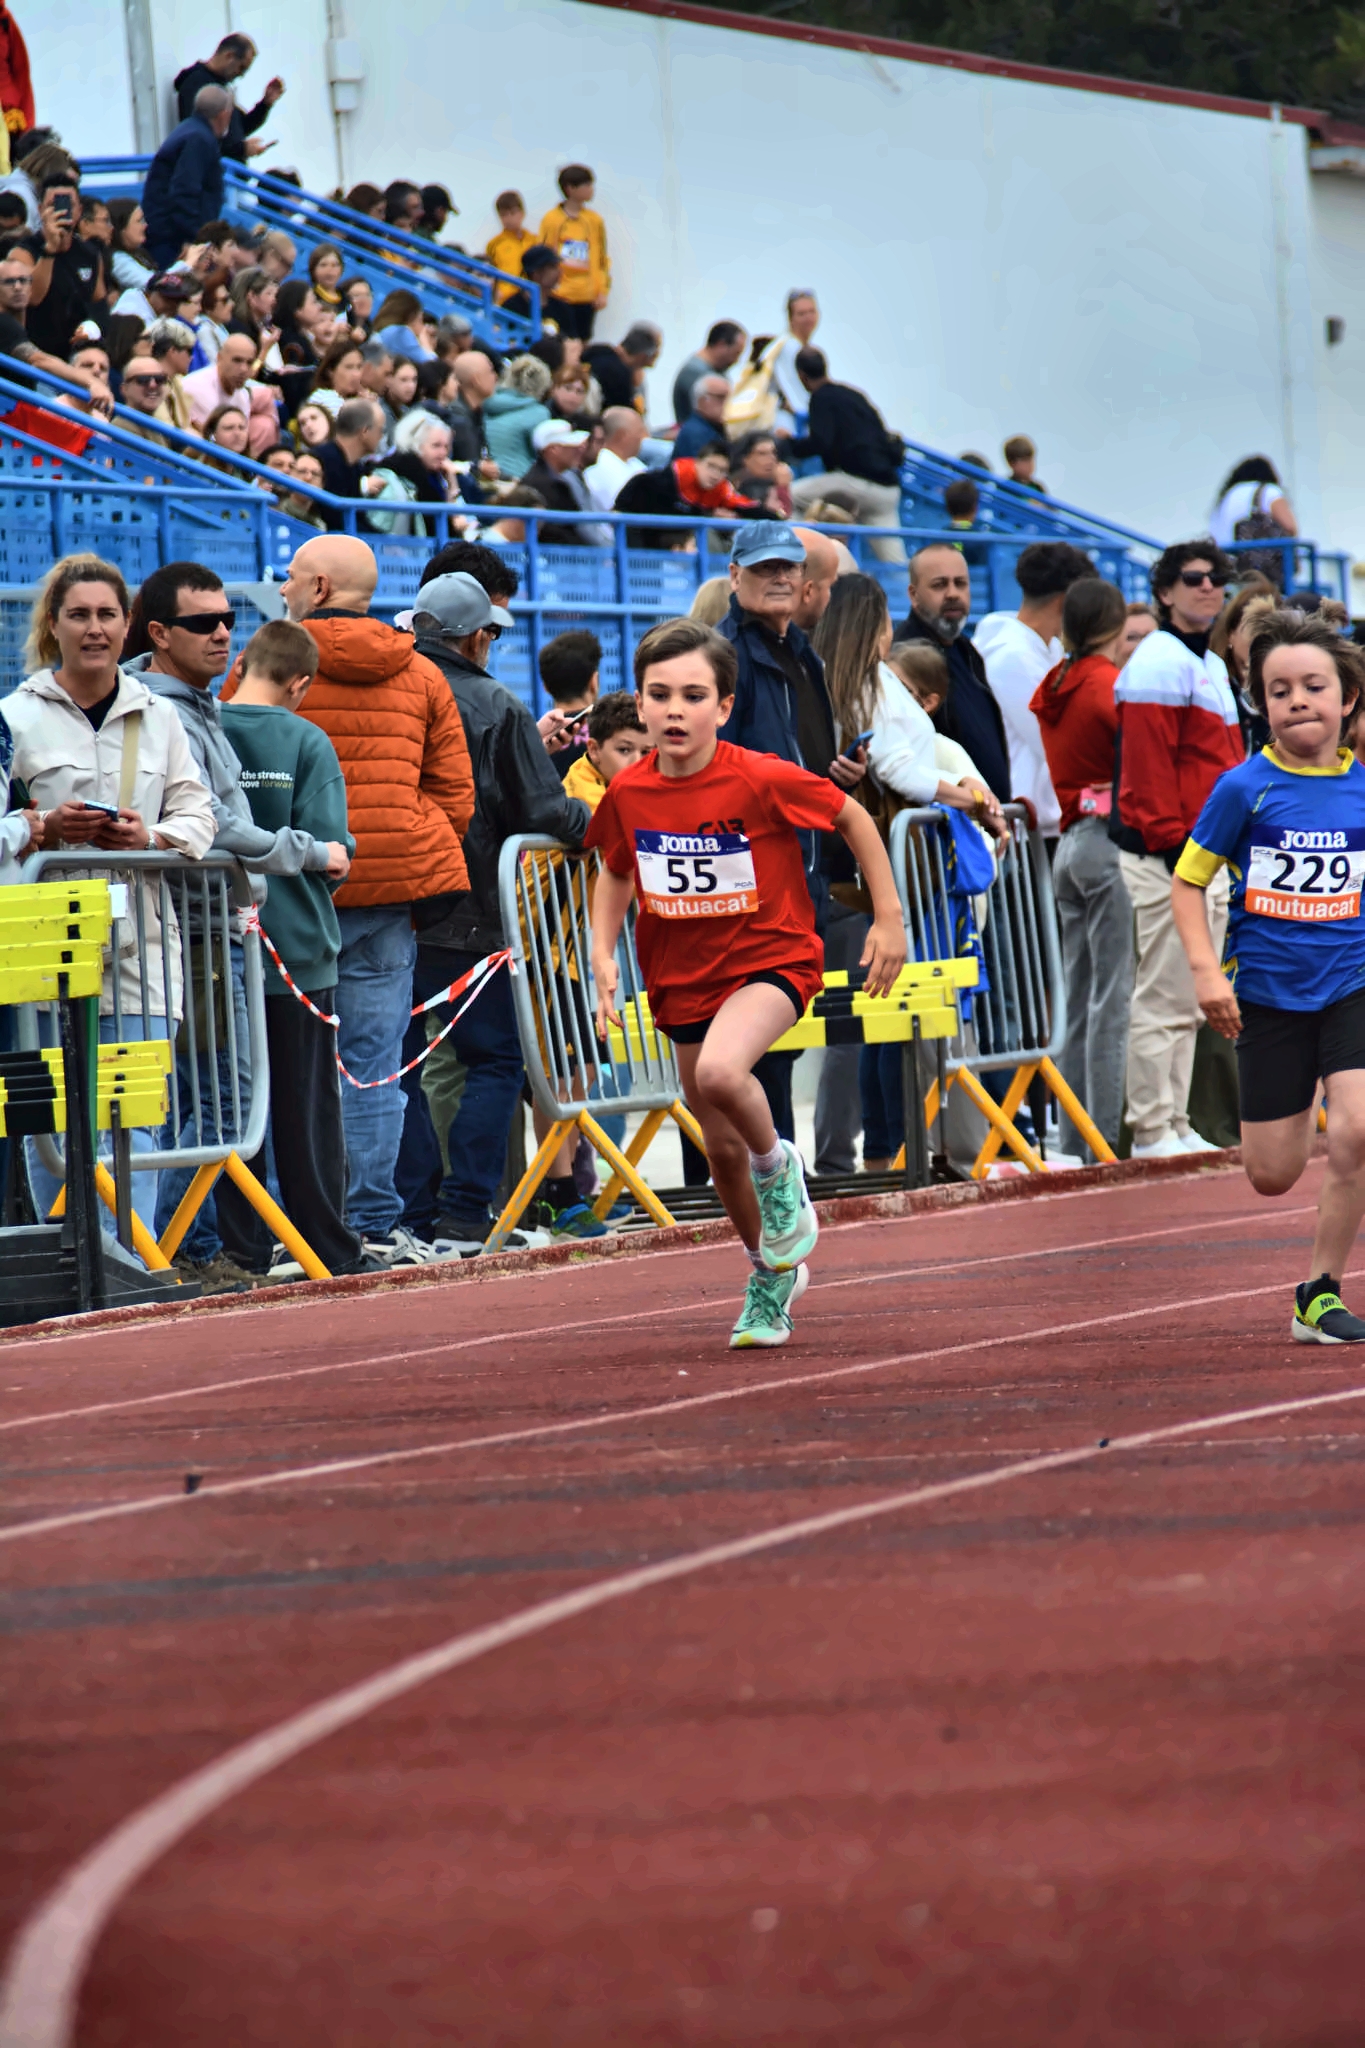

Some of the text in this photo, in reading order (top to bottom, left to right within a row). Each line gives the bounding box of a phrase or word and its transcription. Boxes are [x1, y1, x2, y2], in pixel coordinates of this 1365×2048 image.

[242, 771, 257, 780] the
[658, 834, 721, 852] Joma
[1280, 829, 1348, 849] Joma
[667, 858, 718, 894] 55
[1271, 852, 1351, 894] 229
[650, 894, 749, 916] mutuacat
[1255, 896, 1355, 918] mutuacat
